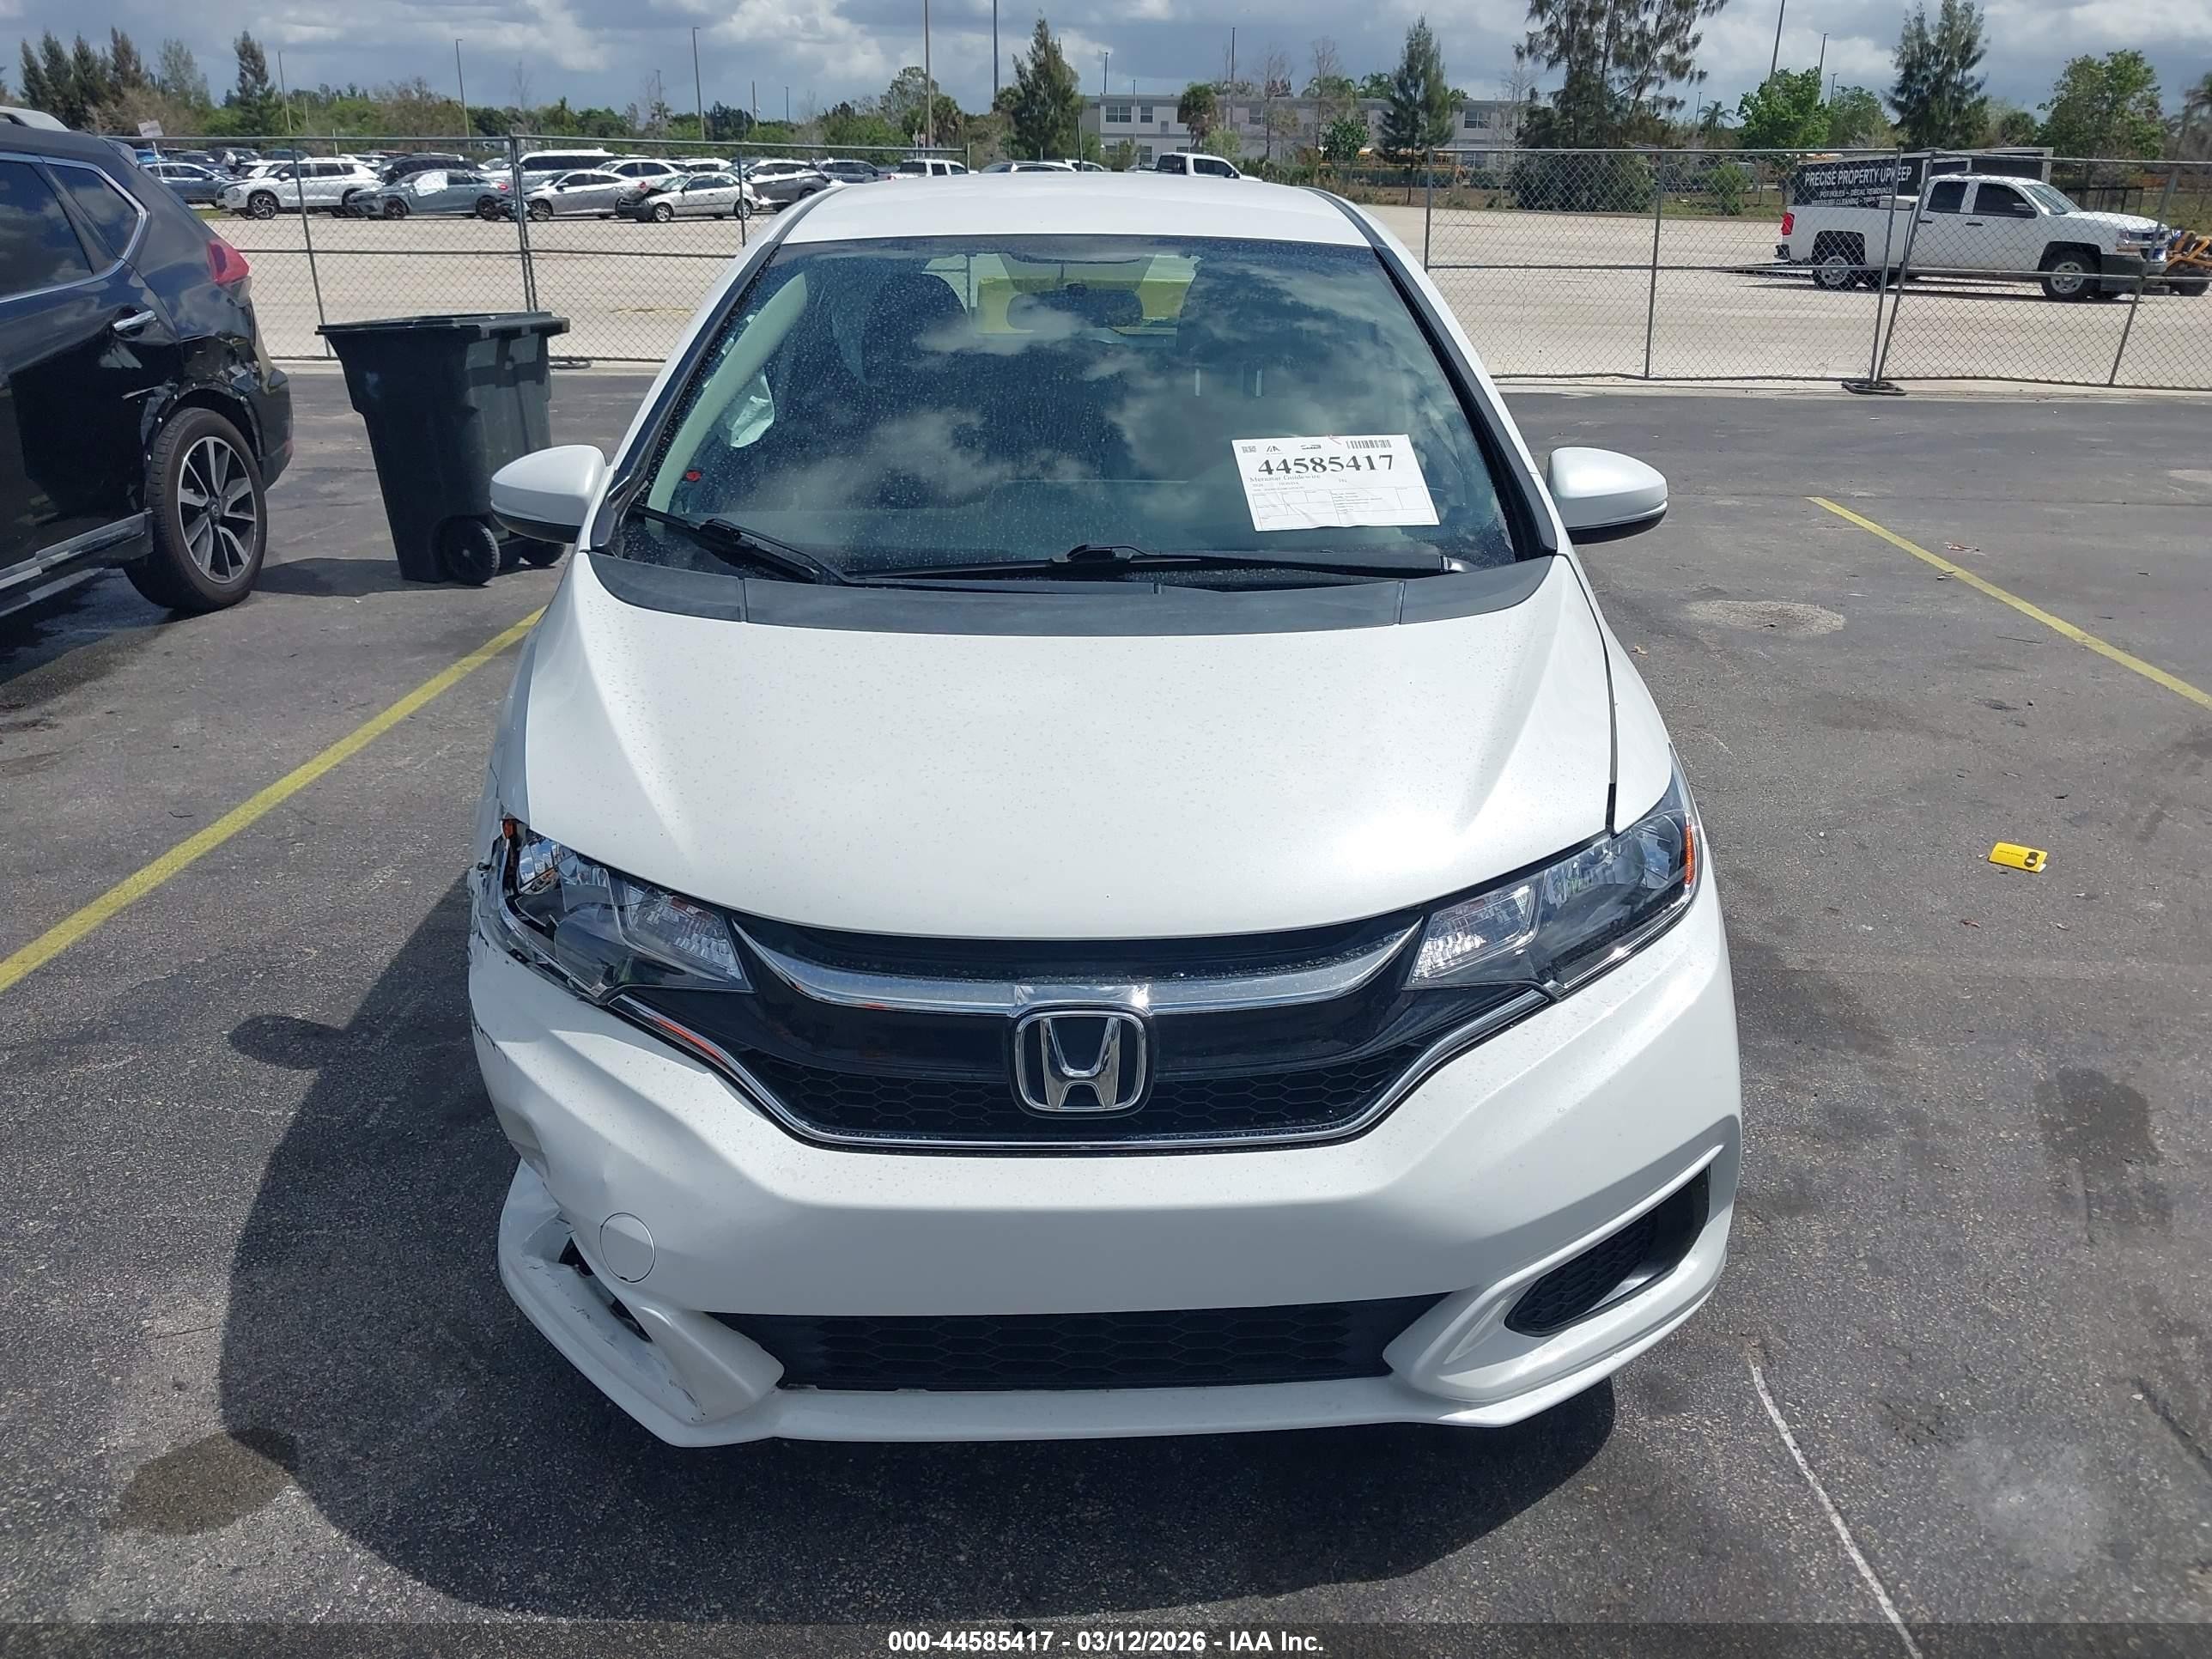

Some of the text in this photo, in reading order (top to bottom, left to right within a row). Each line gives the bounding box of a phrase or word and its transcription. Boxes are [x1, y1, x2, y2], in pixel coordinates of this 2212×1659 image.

[1804, 166, 1912, 186] PRECISE PROPERTY UPKEEP
[1258, 454, 1395, 476] 44585417
